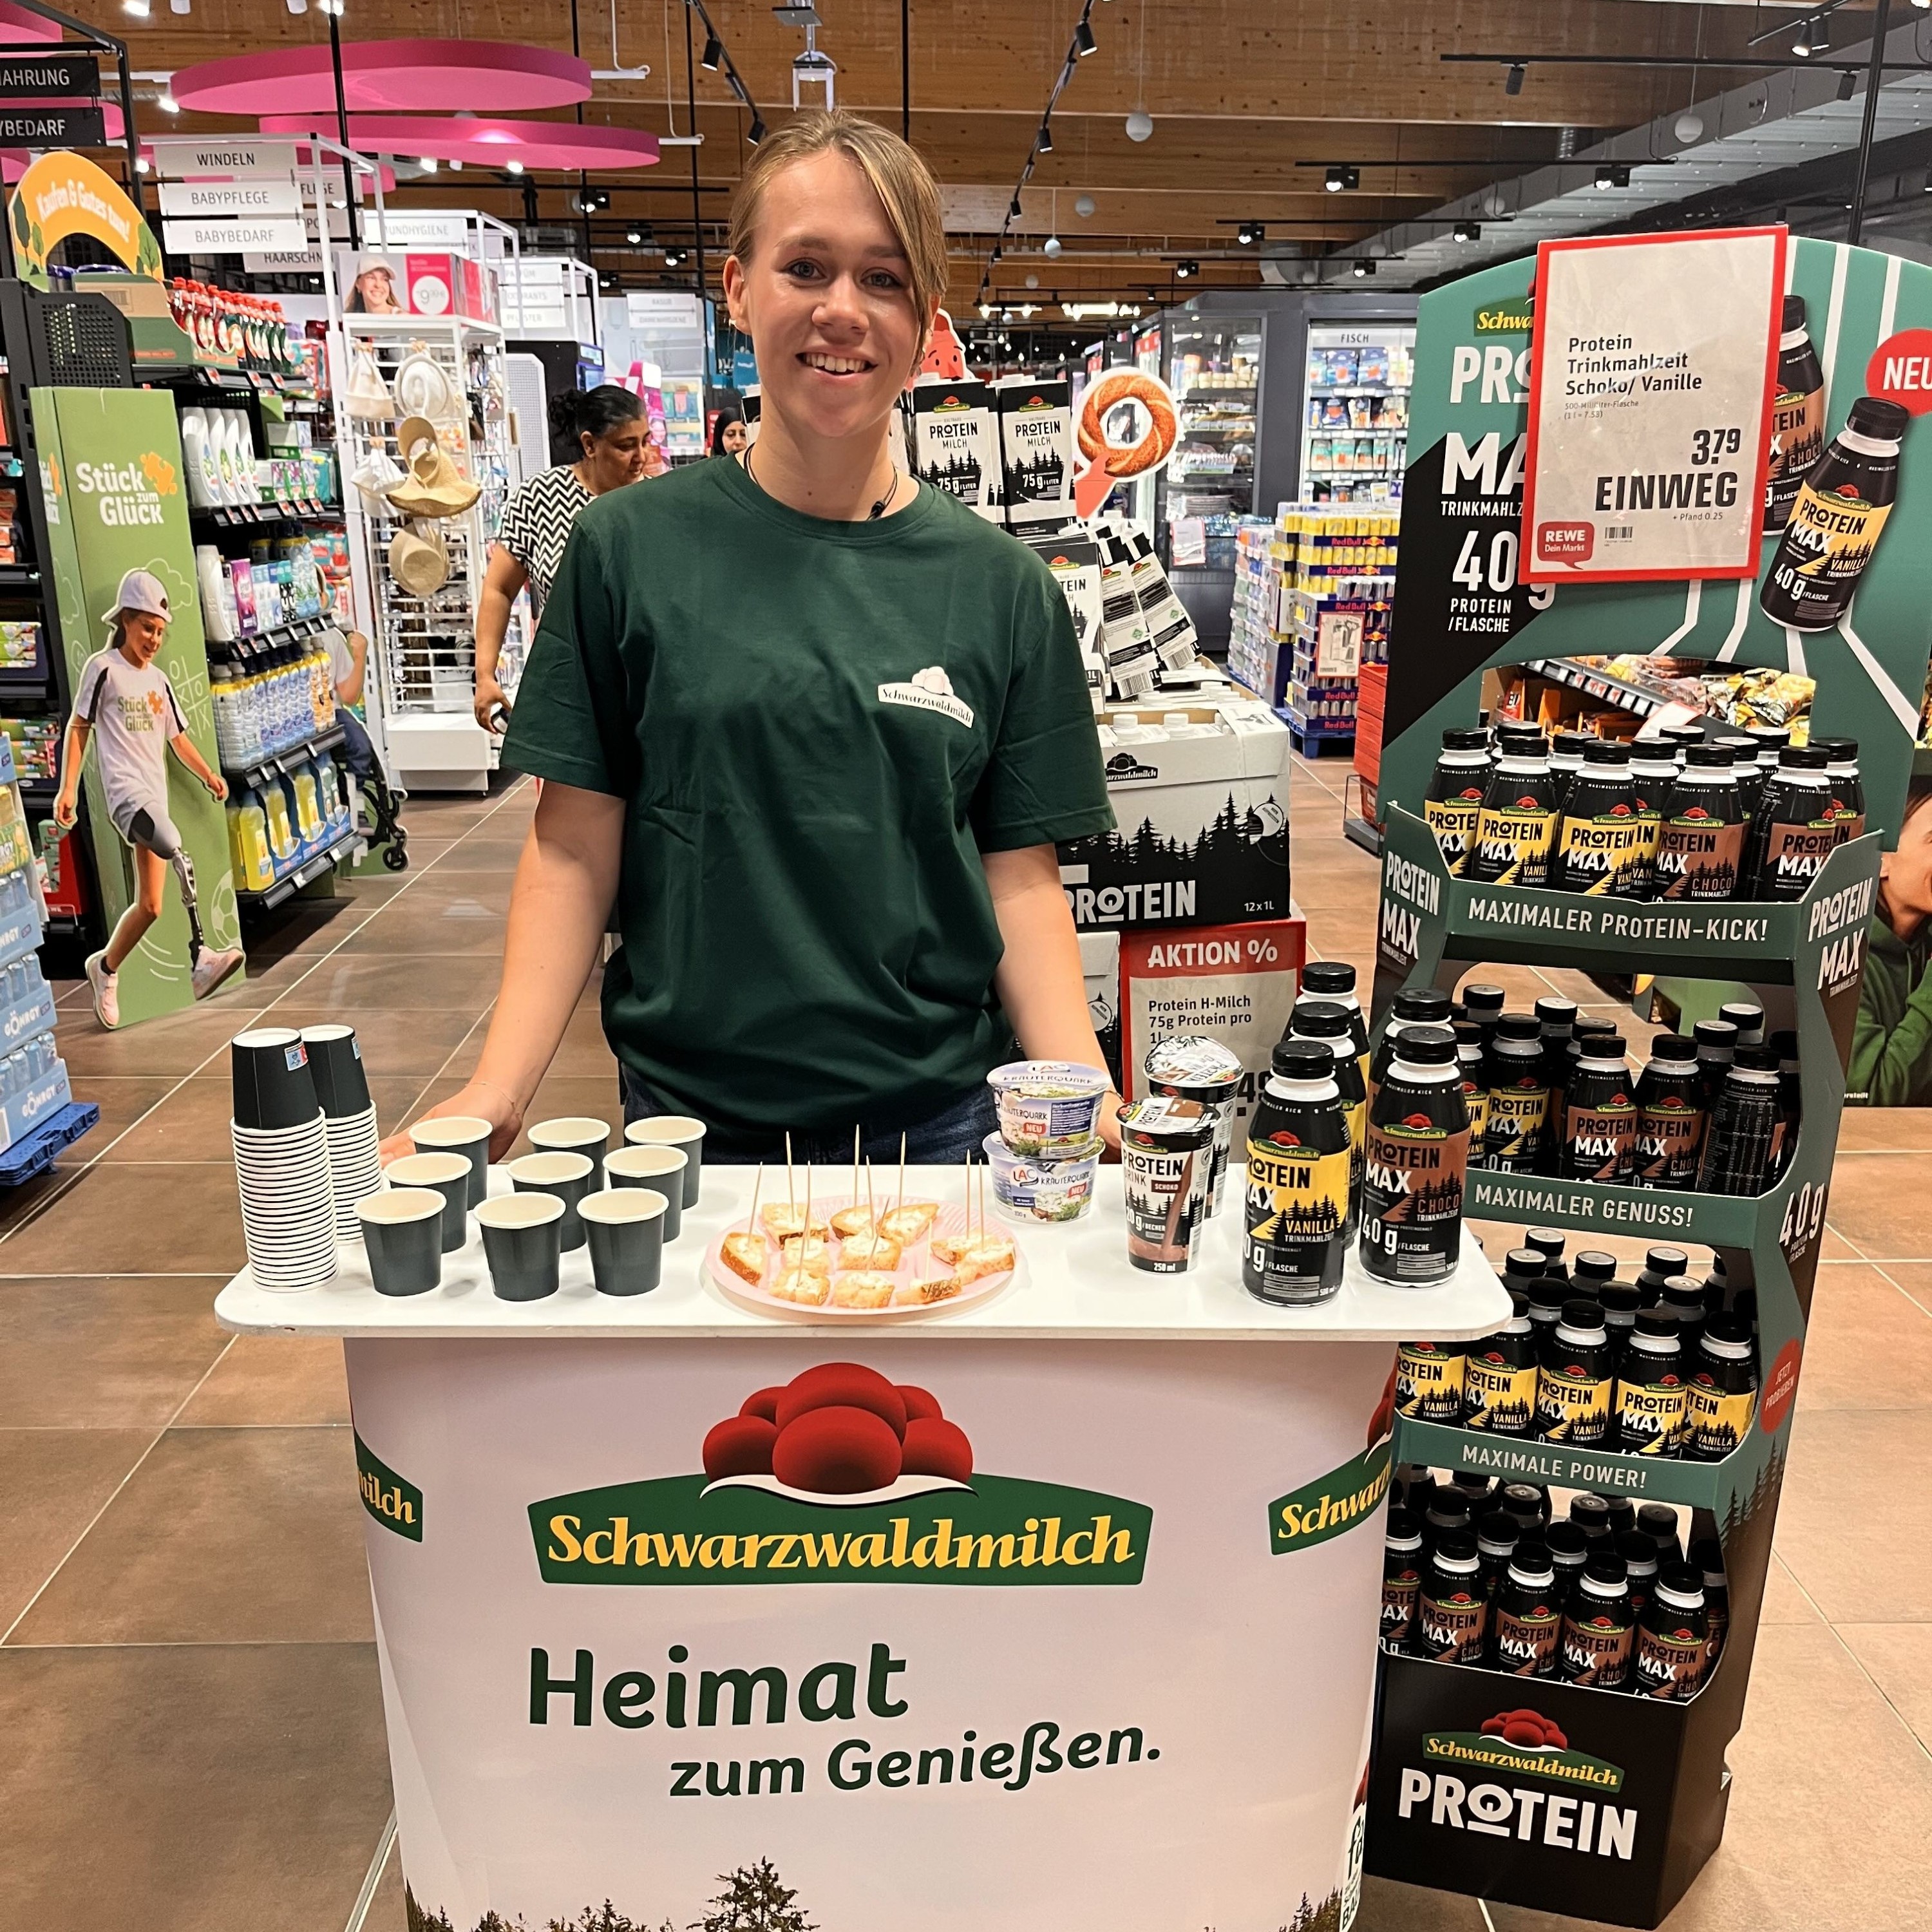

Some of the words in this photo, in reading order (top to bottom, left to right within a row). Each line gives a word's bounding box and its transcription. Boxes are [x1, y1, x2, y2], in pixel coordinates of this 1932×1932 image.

[196, 153, 255, 166] WINDELN
[191, 191, 269, 205] BABYPFLEGE
[195, 229, 274, 243] BABYBEDARF
[1341, 334, 1369, 343] FISCH
[1569, 334, 1633, 352] Protein
[1567, 352, 1689, 374] Trinkmahlzeit
[1566, 375, 1636, 395] Schoko/
[1642, 374, 1702, 392] Vanille
[929, 422, 978, 439] PROTEIN
[1015, 421, 1061, 437] PROTEIN
[942, 438, 967, 449] MILCH
[1027, 436, 1051, 447] MILCH
[76, 462, 147, 495] Stück
[137, 492, 159, 504] zum
[1595, 471, 1738, 511] EINWEG
[100, 495, 164, 527] Glück
[1680, 512, 1703, 521] Pfand
[1704, 512, 1723, 520] 0.25
[1799, 498, 1867, 535] PROTEIN
[1545, 529, 1586, 542] REWE
[1790, 522, 1836, 554] MAX
[1544, 544, 1561, 553] Dein
[1562, 544, 1585, 552] Markt
[1452, 530, 1518, 592] 40
[1831, 556, 1868, 571] VANILLA
[1774, 564, 1795, 590] 40
[1790, 580, 1806, 601] g
[1450, 598, 1511, 614] PROTEIN
[1448, 616, 1510, 632] /FLASCHE
[883, 688, 971, 723] Schwarzwaldmilch
[1483, 819, 1543, 841] PROTEIN
[1571, 827, 1635, 849] PROTEIN
[1481, 840, 1519, 862] MAX
[1566, 850, 1615, 871] MAX
[1385, 850, 1440, 916] PROTEIN
[1692, 878, 1732, 891] CHOCO
[1468, 898, 1593, 932] MAXIMALER
[1600, 913, 1768, 942] PROTEIN-KICK!
[1808, 877, 1873, 942] PROTEIN
[1382, 898, 1421, 960] MAX
[1148, 940, 1240, 968] AKTION
[1247, 938, 1278, 963] %
[1817, 927, 1865, 990] MAX
[1149, 998, 1197, 1012] Protein
[1201, 995, 1251, 1009] H-Milch
[1149, 1016, 1174, 1029] 75g
[1178, 1012, 1226, 1027] Protein
[1230, 1013, 1252, 1026] pro
[1025, 1124, 1043, 1133] NEU
[1577, 1116, 1633, 1135] PROTEIN
[1368, 1134, 1440, 1168] PROTEIN
[1575, 1135, 1618, 1157] MAX
[1122, 1149, 1184, 1176] PROTEIN
[1155, 1182, 1179, 1191] SCHOKO
[1365, 1159, 1412, 1194] MAX
[1417, 1193, 1460, 1214] CHOCO
[1474, 1184, 1595, 1217] MAXIMALER
[1602, 1199, 1694, 1227] GENUSS!
[1285, 1218, 1335, 1235] VANILLA
[1385, 1229, 1398, 1255] g
[1397, 1242, 1430, 1251] /FLASCHE
[1153, 1262, 1166, 1271] 250
[1265, 1260, 1299, 1273] /FLASCHE
[1424, 1401, 1458, 1412] VANILLA
[1624, 1391, 1684, 1414] PROTEIN
[1493, 1412, 1527, 1425] VANILLA
[1573, 1423, 1605, 1435] VANILLA
[1622, 1410, 1664, 1434] MAX
[1697, 1433, 1732, 1446] VANILLA
[1462, 1444, 1563, 1477] MAXIMALE
[1570, 1462, 1647, 1488] POWER!
[548, 1514, 1135, 1569] Schwarzwaldmilch
[1423, 1604, 1477, 1629] PROTEIN
[1422, 1618, 1459, 1646] MAX
[1502, 1620, 1554, 1642] PROTEIN
[1566, 1625, 1619, 1653] PROTEIN
[1500, 1634, 1538, 1659] MAX
[1563, 1640, 1597, 1669] MAX
[1642, 1636, 1698, 1664] PROTEIN
[1638, 1652, 1678, 1681] MAX
[530, 1643, 909, 1730] Heimat
[670, 1754, 805, 1797] zum
[827, 1721, 1160, 1792] Genießen.
[1426, 1738, 1618, 1788] Schwarzwaldmilch
[1398, 1767, 1638, 1861] PROTEIN
